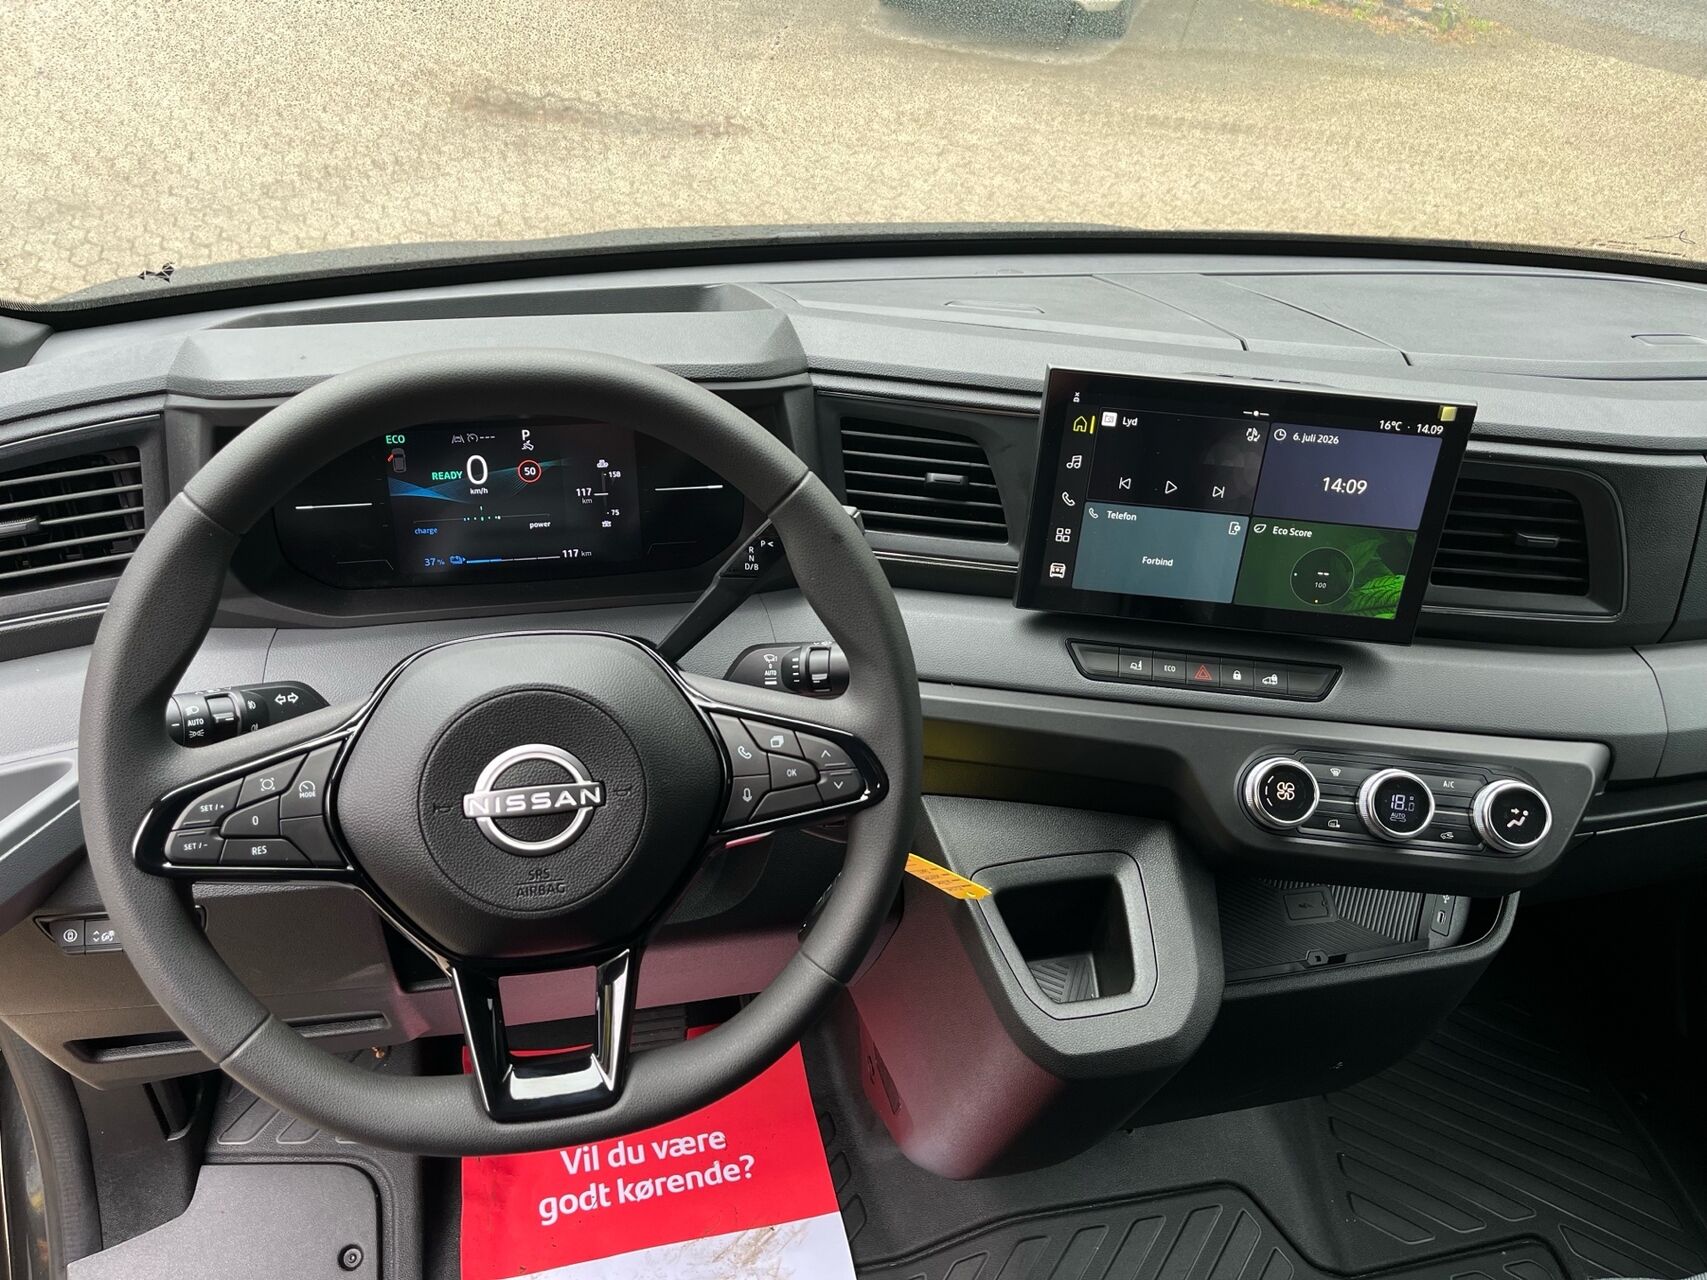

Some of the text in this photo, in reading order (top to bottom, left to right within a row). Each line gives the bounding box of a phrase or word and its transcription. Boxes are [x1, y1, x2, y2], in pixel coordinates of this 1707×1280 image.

[1122, 416, 1138, 427] Lyd
[1416, 423, 1444, 435] 14.09
[385, 435, 406, 444] ECO
[521, 429, 531, 441] P
[1292, 432, 1340, 445] 6. juli 2026
[466, 454, 488, 485] 0
[524, 467, 536, 476] 50
[608, 470, 621, 478] 158
[431, 471, 463, 481] READY
[1322, 477, 1368, 495] 14:09
[576, 487, 592, 497] 117
[1106, 510, 1137, 522] Telefon
[529, 521, 551, 530] power
[414, 526, 438, 536] charge
[1272, 526, 1313, 538] Eco Score
[748, 545, 754, 553] R
[760, 540, 766, 548] P
[562, 549, 579, 558] 117
[748, 554, 755, 562] N
[1141, 555, 1174, 567] Forbind
[744, 563, 759, 571] D/B
[1314, 581, 1327, 589] 100
[1164, 664, 1176, 672] ECO
[187, 717, 204, 727] AUTO
[786, 768, 798, 777] OK
[1443, 780, 1455, 789] A/C
[469, 787, 601, 815] NISSAN
[200, 803, 213, 812] SET
[252, 816, 259, 826] 0
[183, 843, 197, 851] SET
[251, 845, 268, 856] RES
[528, 869, 550, 881] SRS
[516, 884, 566, 898] AIRBAG
[560, 1131, 726, 1175] Vil du være
[538, 1154, 755, 1226] godt kørende?
